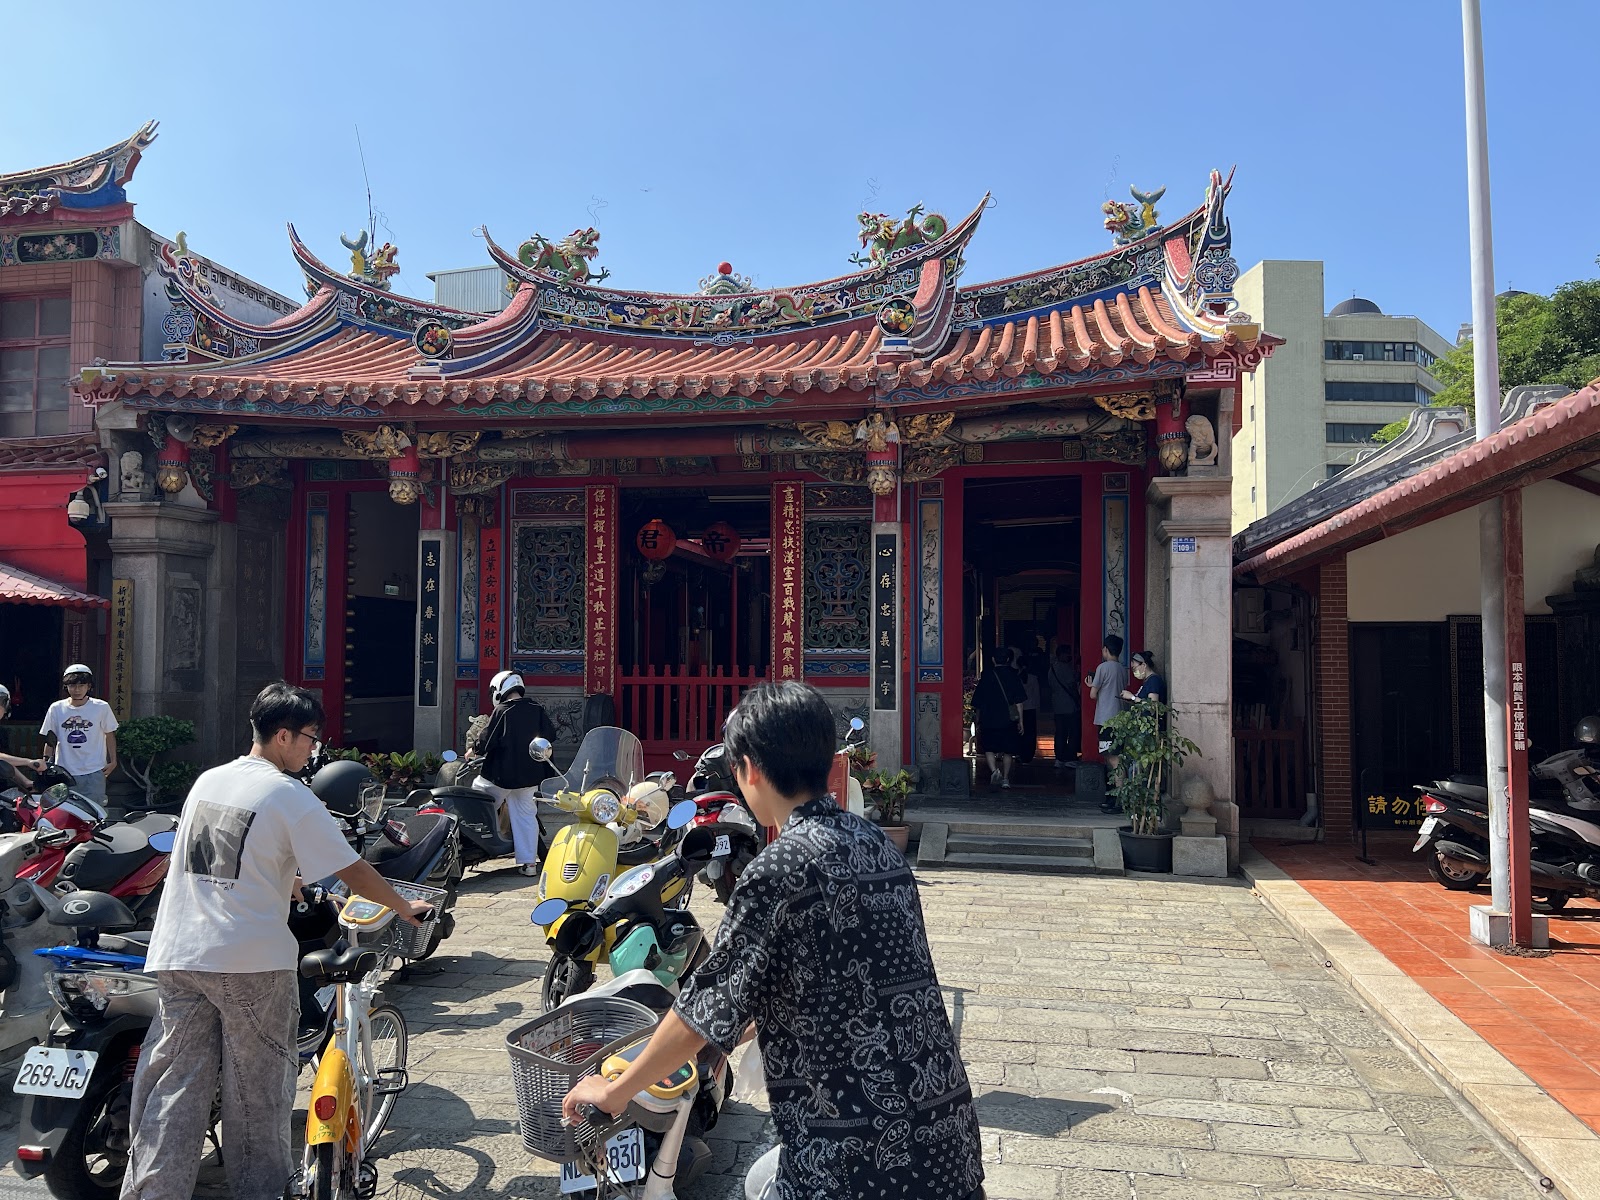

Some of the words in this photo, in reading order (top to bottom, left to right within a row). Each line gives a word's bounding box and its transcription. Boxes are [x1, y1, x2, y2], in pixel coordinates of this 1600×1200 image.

[639, 529, 663, 550] 君
[423, 552, 437, 692] 志在春秋一書
[878, 548, 893, 695] 心存忠義二字
[1511, 662, 1526, 751] 限本廟員工停放車輛
[17, 1063, 91, 1091] 269-JGJ
